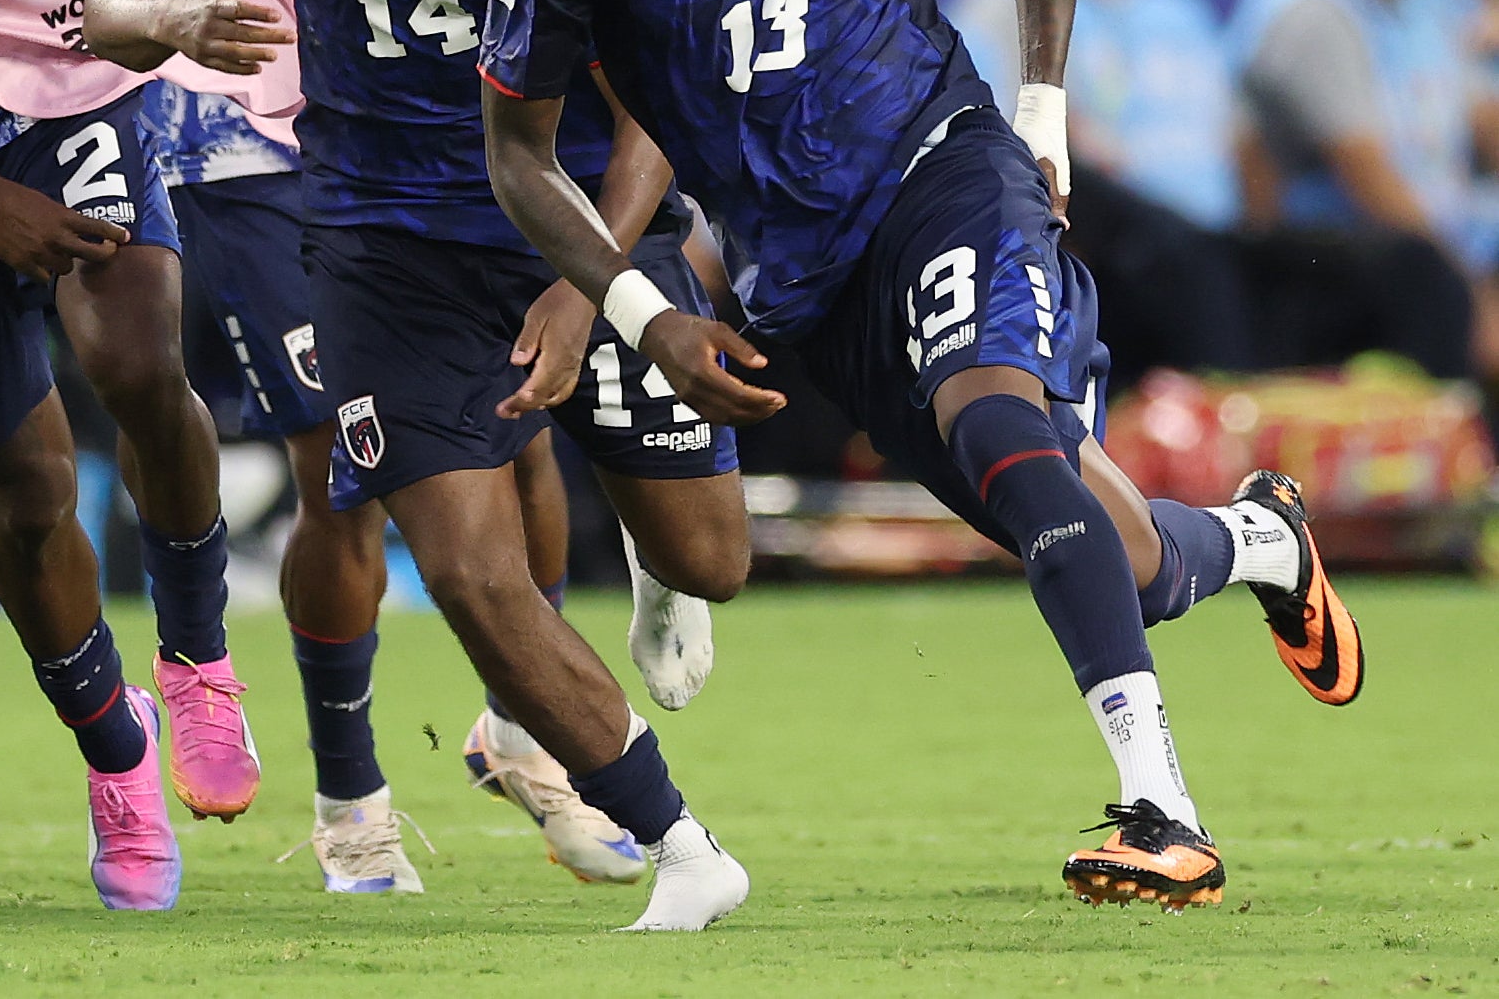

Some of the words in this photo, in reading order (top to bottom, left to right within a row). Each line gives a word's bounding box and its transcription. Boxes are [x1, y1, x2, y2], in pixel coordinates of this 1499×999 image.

[56, 121, 129, 209] 2
[76, 201, 136, 220] apelli
[925, 322, 977, 367] capelli
[341, 400, 370, 420] FCF
[642, 422, 712, 451] capelli
[675, 441, 712, 452] SPORT
[1109, 712, 1135, 735] SLC
[1117, 728, 1132, 745] 13
